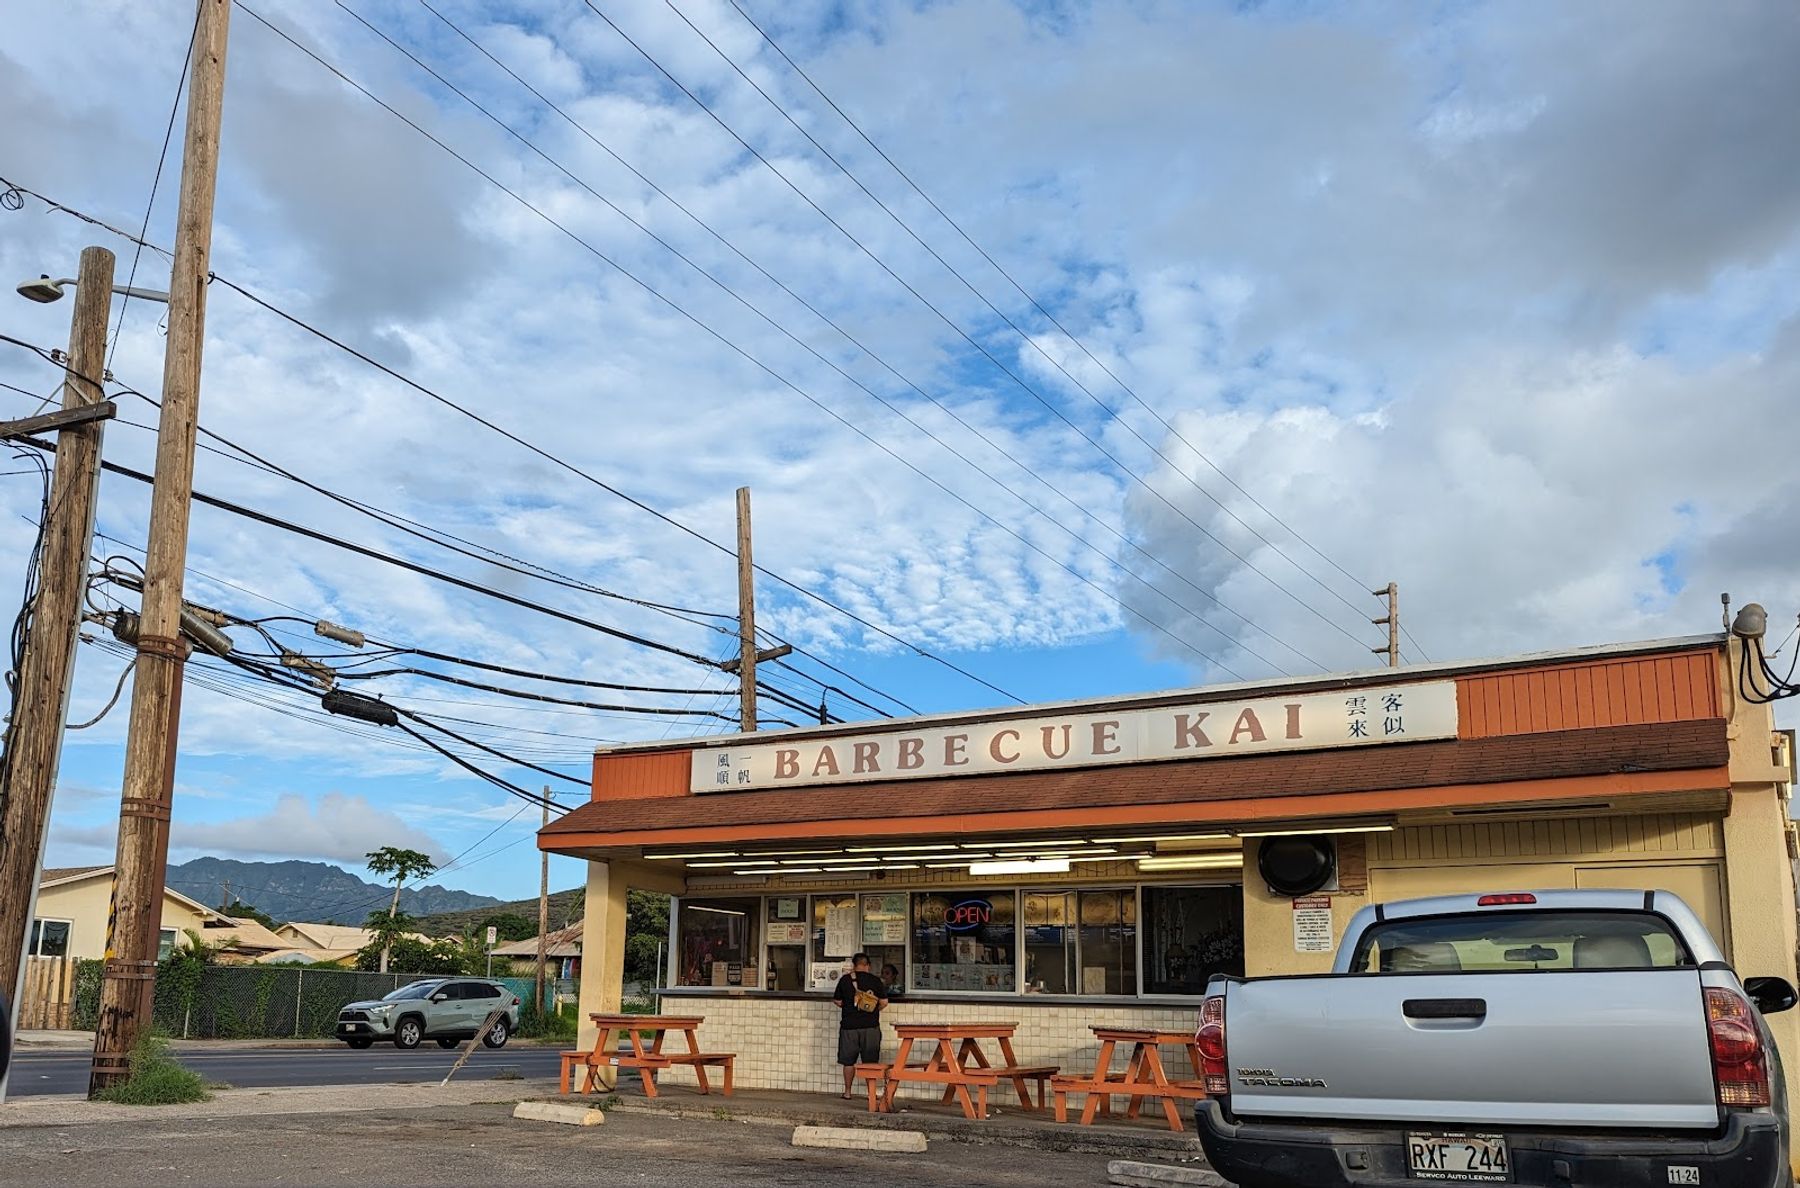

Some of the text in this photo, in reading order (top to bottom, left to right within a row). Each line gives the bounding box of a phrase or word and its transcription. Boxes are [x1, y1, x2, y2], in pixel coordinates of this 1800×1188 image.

[1345, 696, 1369, 738] 雲來
[1381, 693, 1405, 735] 客似
[773, 703, 1304, 780] BARBECUE KAI
[716, 753, 730, 785] 風順
[738, 755, 752, 784] 一帆
[943, 906, 991, 924] OPEN
[1237, 1067, 1276, 1076] TOYOTA
[1238, 1077, 1328, 1088] TACOMA
[1411, 1143, 1507, 1172] RXF 244
[1468, 1173, 1507, 1181] LEEWARD
